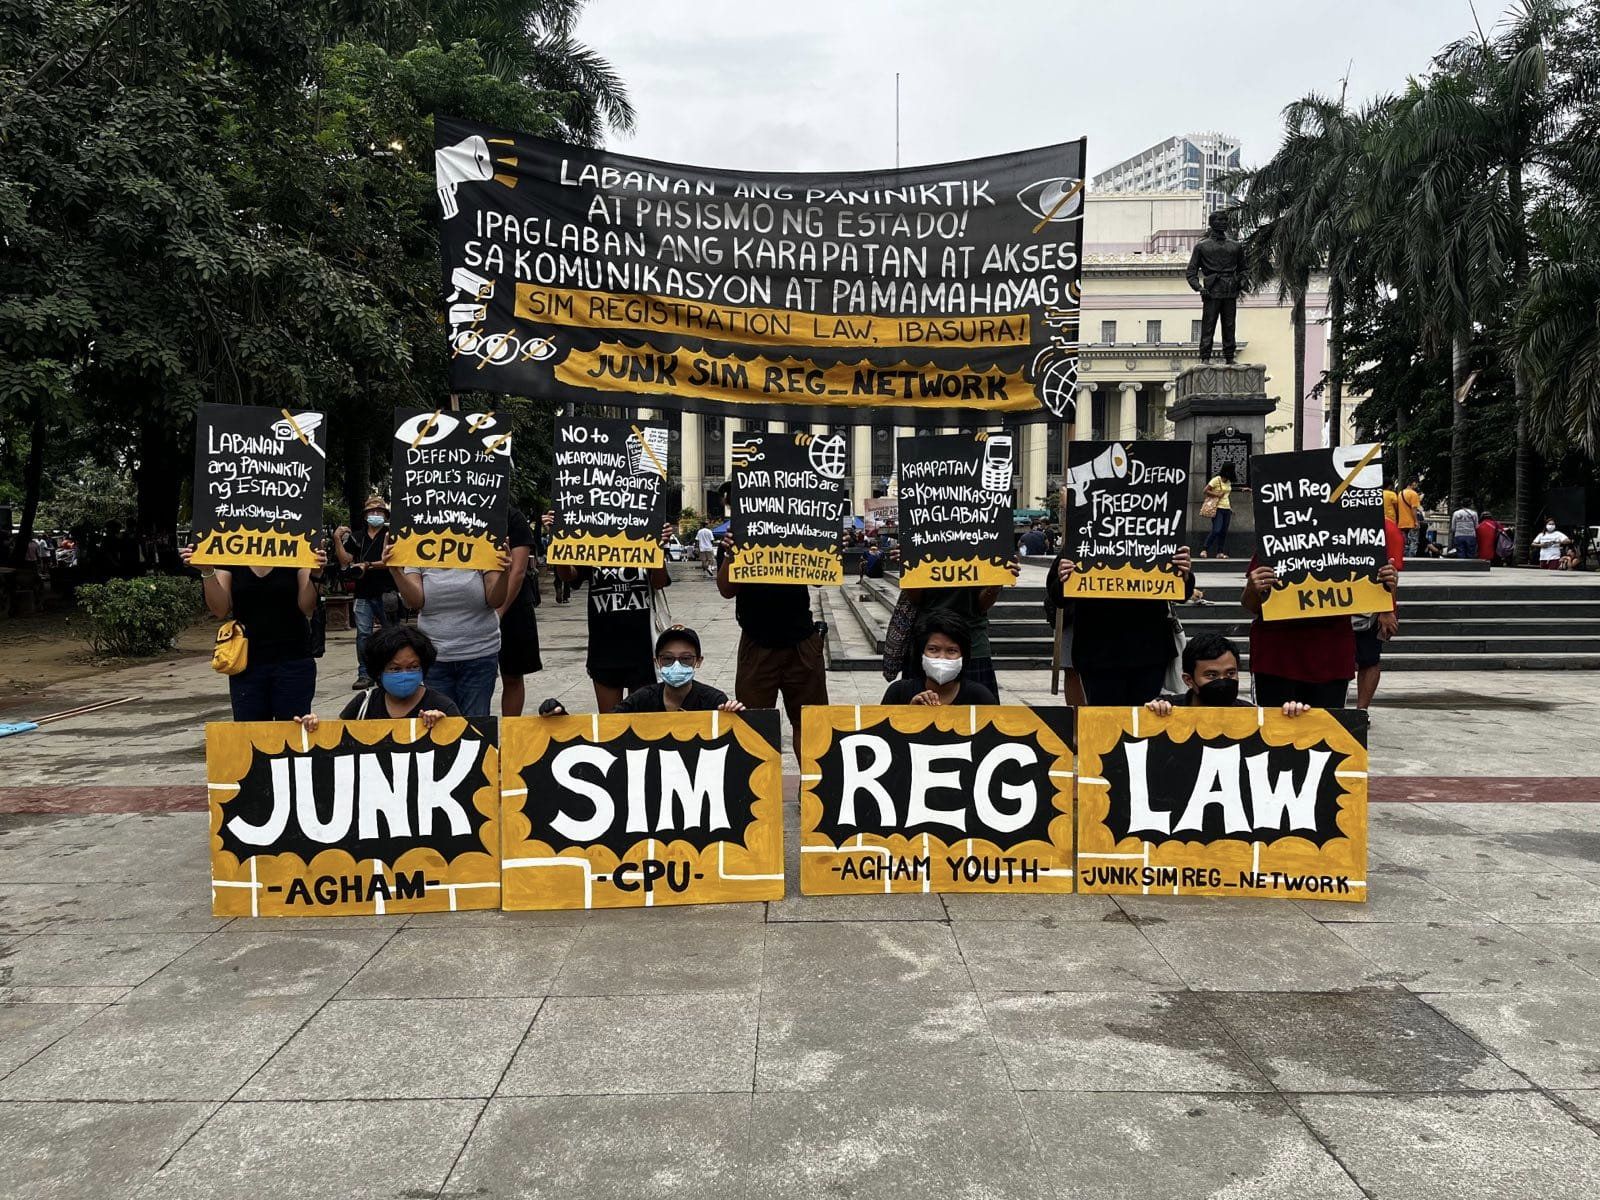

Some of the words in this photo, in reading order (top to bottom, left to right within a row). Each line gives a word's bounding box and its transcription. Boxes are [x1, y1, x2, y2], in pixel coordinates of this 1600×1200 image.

[561, 158, 715, 196] LABANAN
[734, 180, 794, 200] ANG
[806, 179, 996, 206] PANINIKTIK
[588, 194, 627, 226] AT
[636, 197, 774, 231] PASISMO
[782, 206, 824, 238] NG
[837, 209, 969, 240] ESTADO!
[476, 210, 646, 257] IPAGLABAN
[656, 234, 724, 265] ANG
[733, 236, 927, 279] KARAPATAN
[941, 245, 975, 279] AT
[981, 242, 1078, 275] AKSES
[464, 241, 504, 274] SA
[514, 248, 772, 304] KOMUNIKASYON
[785, 277, 823, 311] AT
[832, 274, 1059, 314] PAMAMAHAYAG
[528, 291, 574, 318] SIM
[589, 296, 791, 336] REGISTRATION
[813, 317, 878, 344] LAW,
[898, 317, 1026, 343] IBASURA!
[586, 353, 679, 387] JUNK
[687, 359, 749, 390] SIM
[762, 366, 1009, 400] REG_NETWORK
[208, 424, 285, 456] LABANAN
[560, 424, 588, 443] NO
[590, 428, 610, 444] to
[207, 460, 238, 481] ang
[240, 456, 313, 481] PANINIKTIK
[406, 448, 471, 465] DEFEND
[474, 450, 496, 463] the
[555, 451, 626, 469] WEAPONIZING
[405, 468, 462, 488] PEOPLE'S
[466, 470, 505, 489] RIGHT
[555, 469, 581, 488] the
[582, 467, 616, 487] LAW
[614, 475, 661, 495] against
[737, 470, 771, 490] DATA
[773, 470, 819, 489] RIGHTS
[818, 479, 839, 492] are
[901, 458, 979, 481] KARAPATAN
[1128, 459, 1186, 486] DEFEND
[209, 481, 232, 500] ng
[235, 475, 308, 500] ESTADO!
[400, 491, 422, 508] to
[425, 489, 497, 510] PRIVACY!
[555, 490, 585, 510] the
[589, 487, 658, 512] PEOPLE!
[900, 488, 916, 500] sa
[1260, 480, 1294, 503] SIM
[1299, 478, 1332, 504] Reg
[1340, 488, 1384, 499] ACCESS
[739, 496, 785, 514] HUMAN
[787, 497, 844, 522] RIGHTS!
[1091, 489, 1168, 521] FREEDOM
[1341, 496, 1384, 508] DENIED
[909, 505, 999, 526] IPAGLABAN!
[1078, 520, 1093, 538] of
[1098, 509, 1183, 538] SPEECH!
[1273, 506, 1318, 529] Law,
[205, 534, 299, 558] AGHAM
[416, 538, 474, 563] CPU
[551, 543, 656, 564] KARAPATAN
[1262, 530, 1330, 557] PAHIRAP
[1331, 534, 1347, 546] sa
[1346, 527, 1386, 547] MASA
[743, 551, 764, 566] UP
[768, 550, 832, 569] INTERNET
[733, 565, 784, 580] FREEDOM
[786, 566, 838, 582] NETWORK
[930, 564, 979, 582] SUKI
[1077, 576, 1176, 595] ALTERMIDYA
[612, 583, 632, 592] THE
[1297, 587, 1354, 611] KMU
[227, 738, 482, 846] JUNK
[549, 744, 732, 842] SIM
[837, 733, 1038, 834] REG
[1123, 740, 1333, 837] LAW
[1141, 867, 1179, 888] SIM
